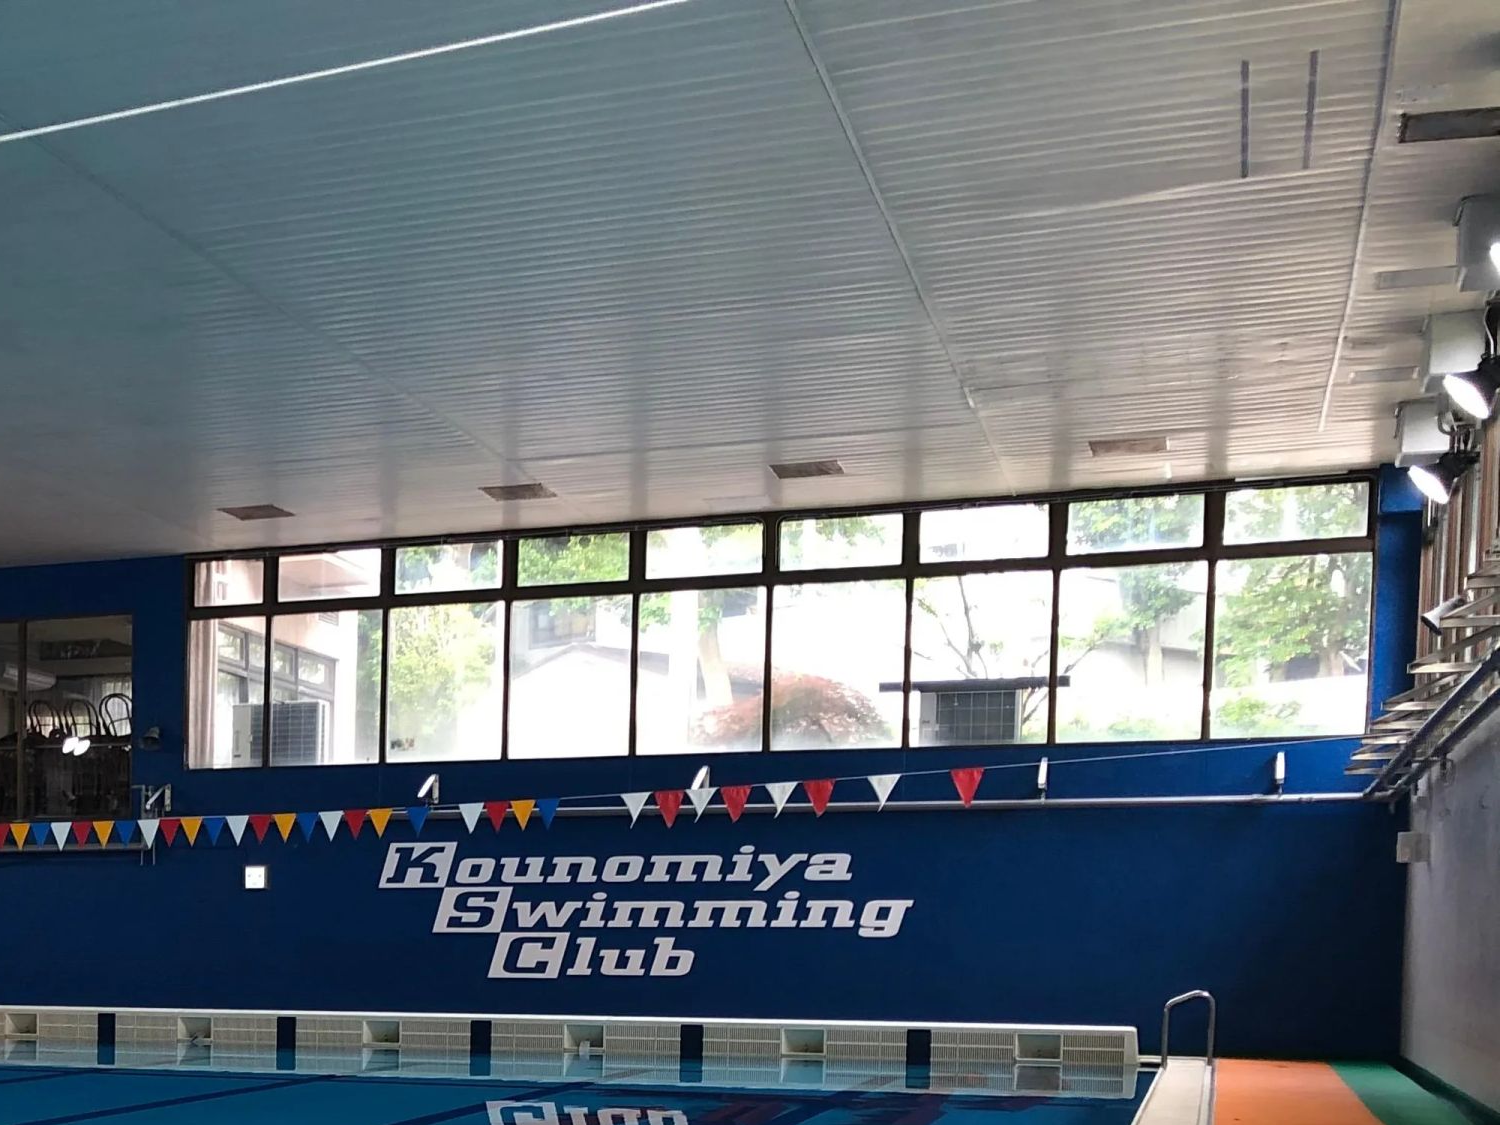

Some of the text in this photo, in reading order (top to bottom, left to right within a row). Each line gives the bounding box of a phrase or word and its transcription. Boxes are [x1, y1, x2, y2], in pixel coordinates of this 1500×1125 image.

[380, 842, 852, 891] Kounomiya
[434, 887, 913, 937] Swimming
[488, 932, 695, 978] Club
